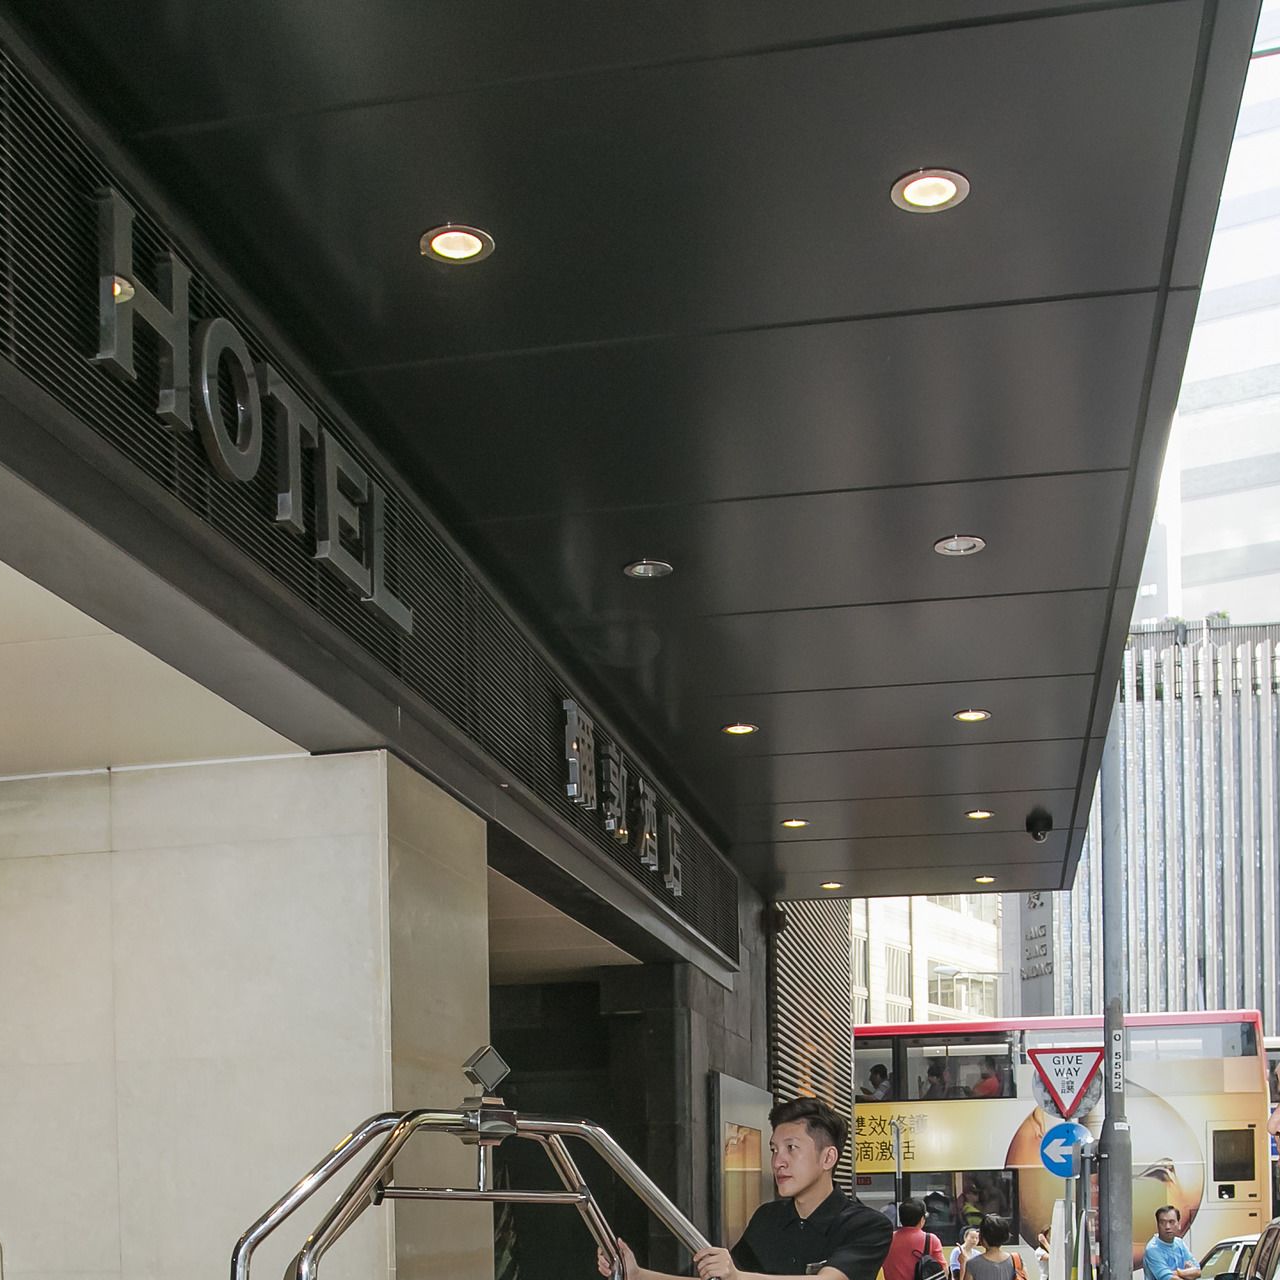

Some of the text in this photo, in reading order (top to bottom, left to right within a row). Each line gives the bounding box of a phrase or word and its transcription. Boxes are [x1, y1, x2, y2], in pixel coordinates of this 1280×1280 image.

[88, 187, 413, 636] HOTEL
[1052, 1055, 1083, 1066] GIVE
[1054, 1067, 1081, 1078] WAY
[1060, 1079, 1075, 1094] 讓
